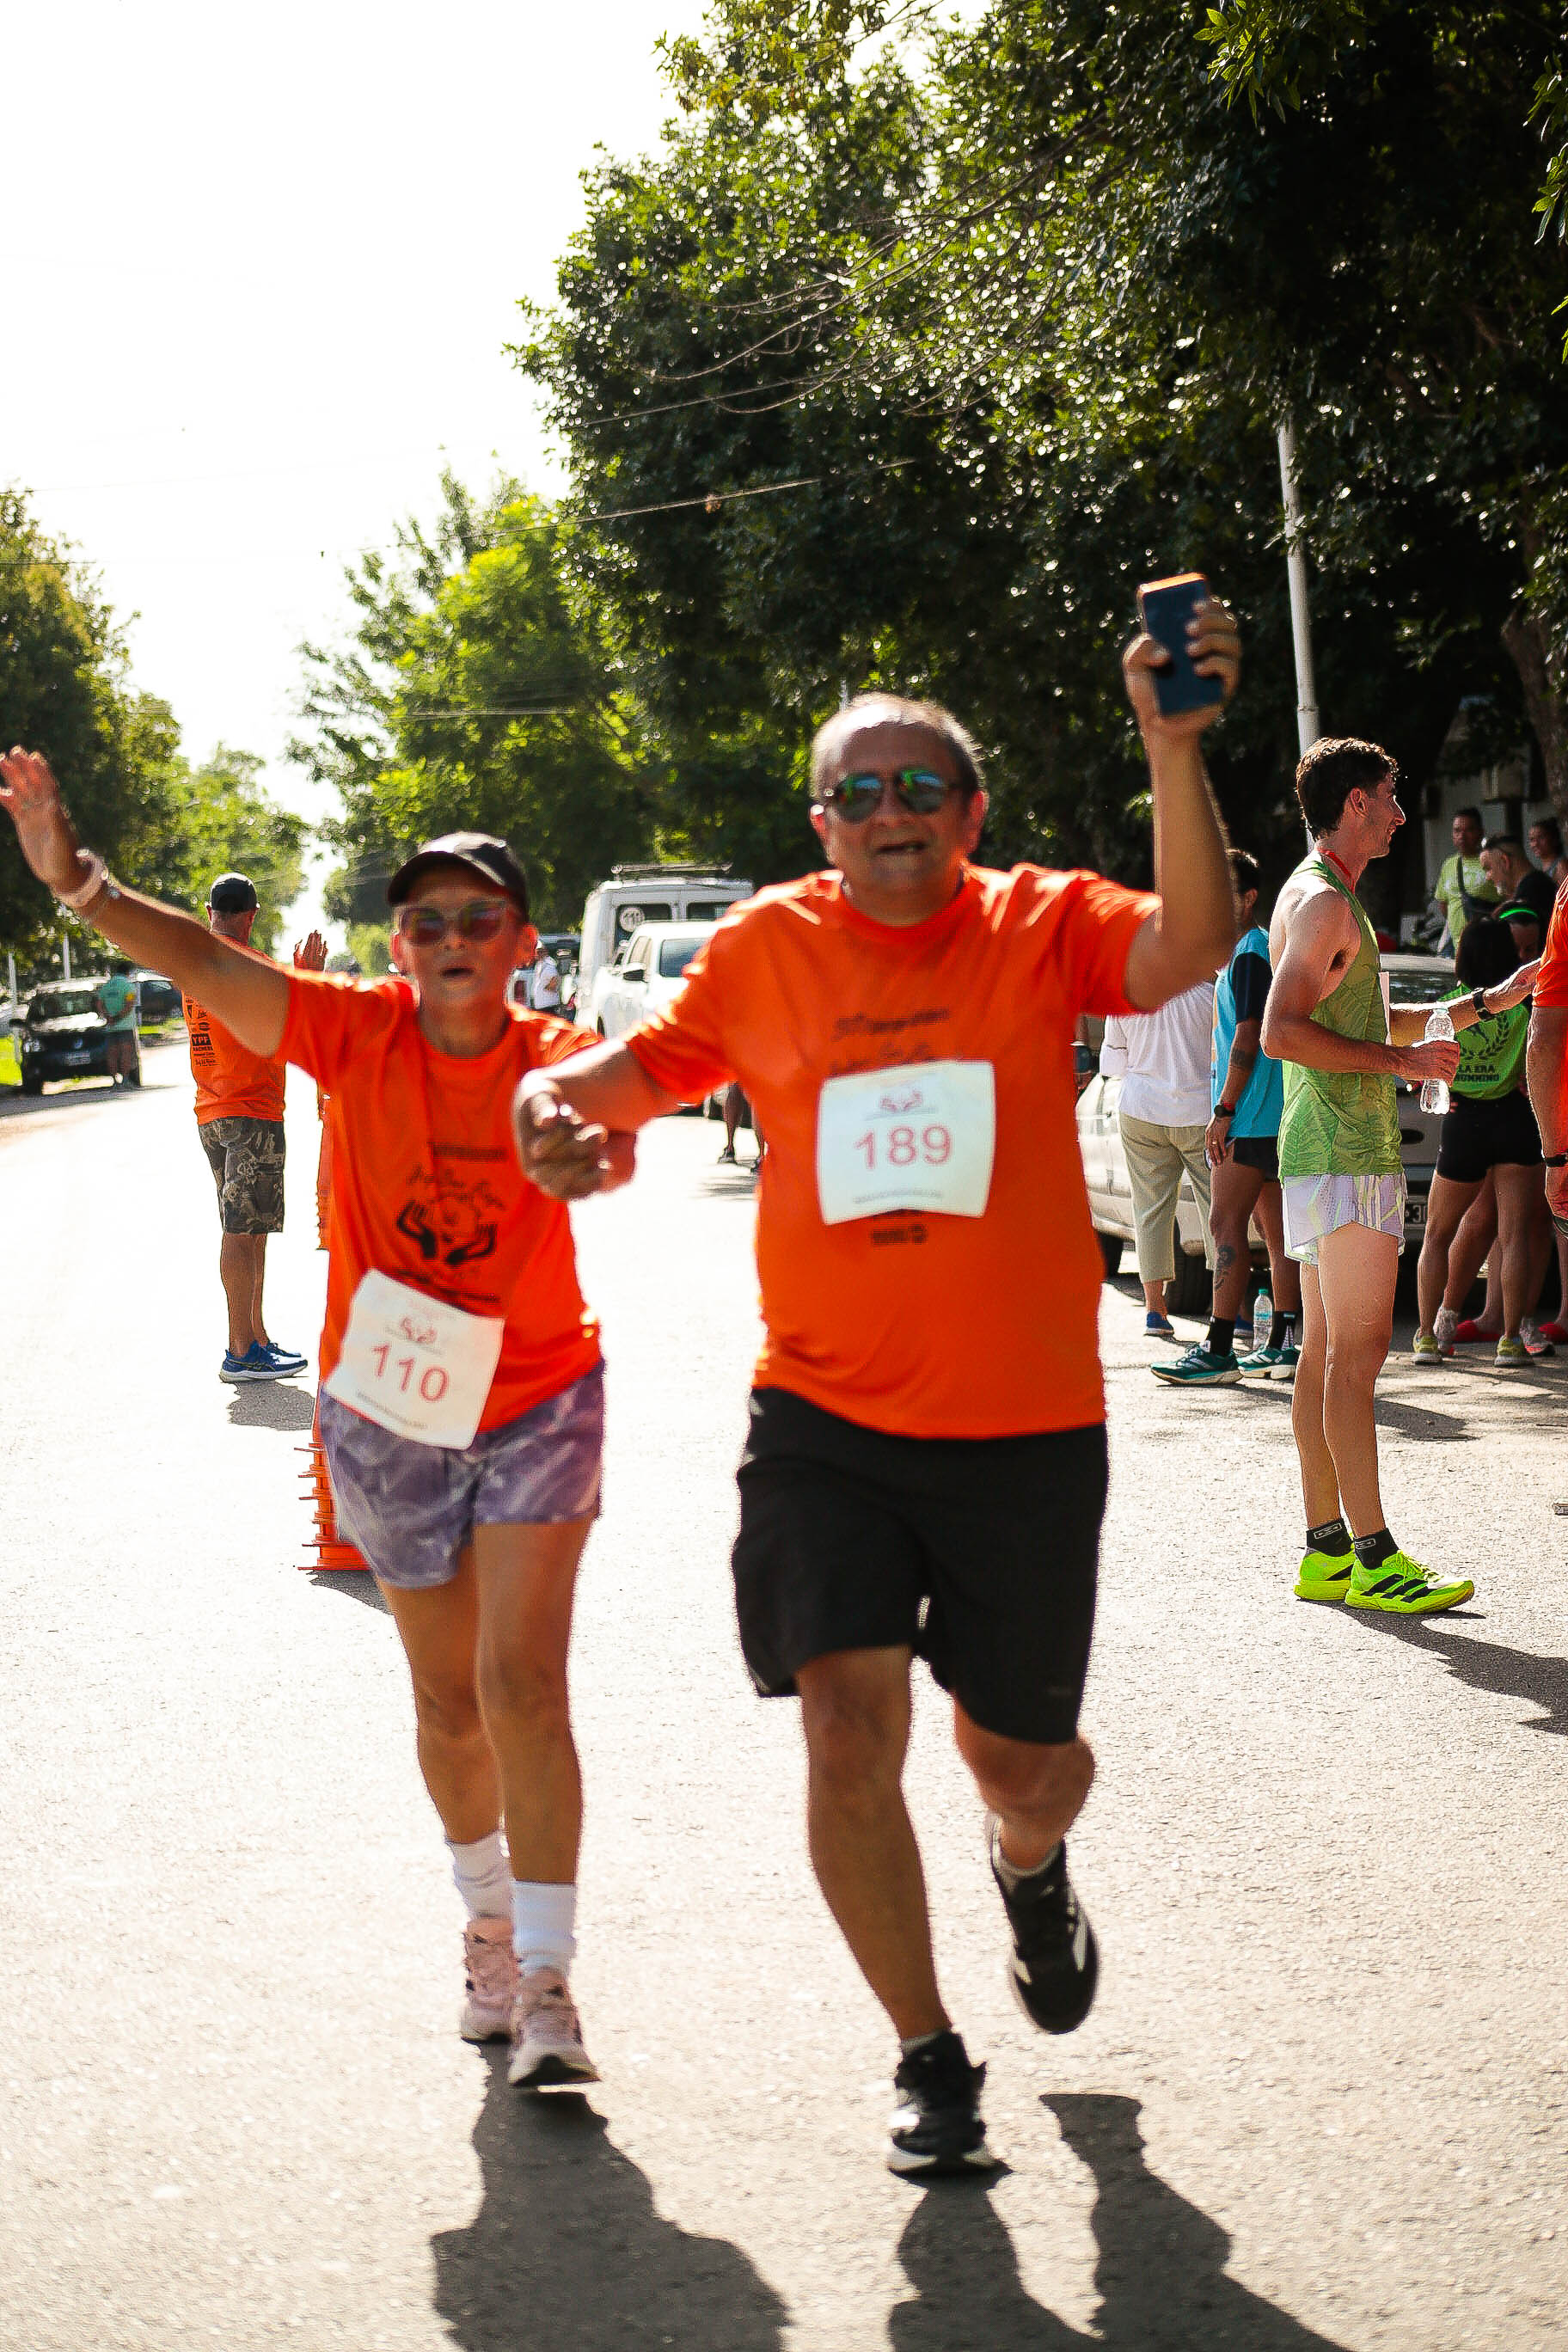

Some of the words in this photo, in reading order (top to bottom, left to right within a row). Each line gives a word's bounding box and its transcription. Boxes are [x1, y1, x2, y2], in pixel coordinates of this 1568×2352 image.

[1474, 1064, 1495, 1073] ERA
[853, 1125, 952, 1171] 189
[371, 1341, 449, 1402] 110
